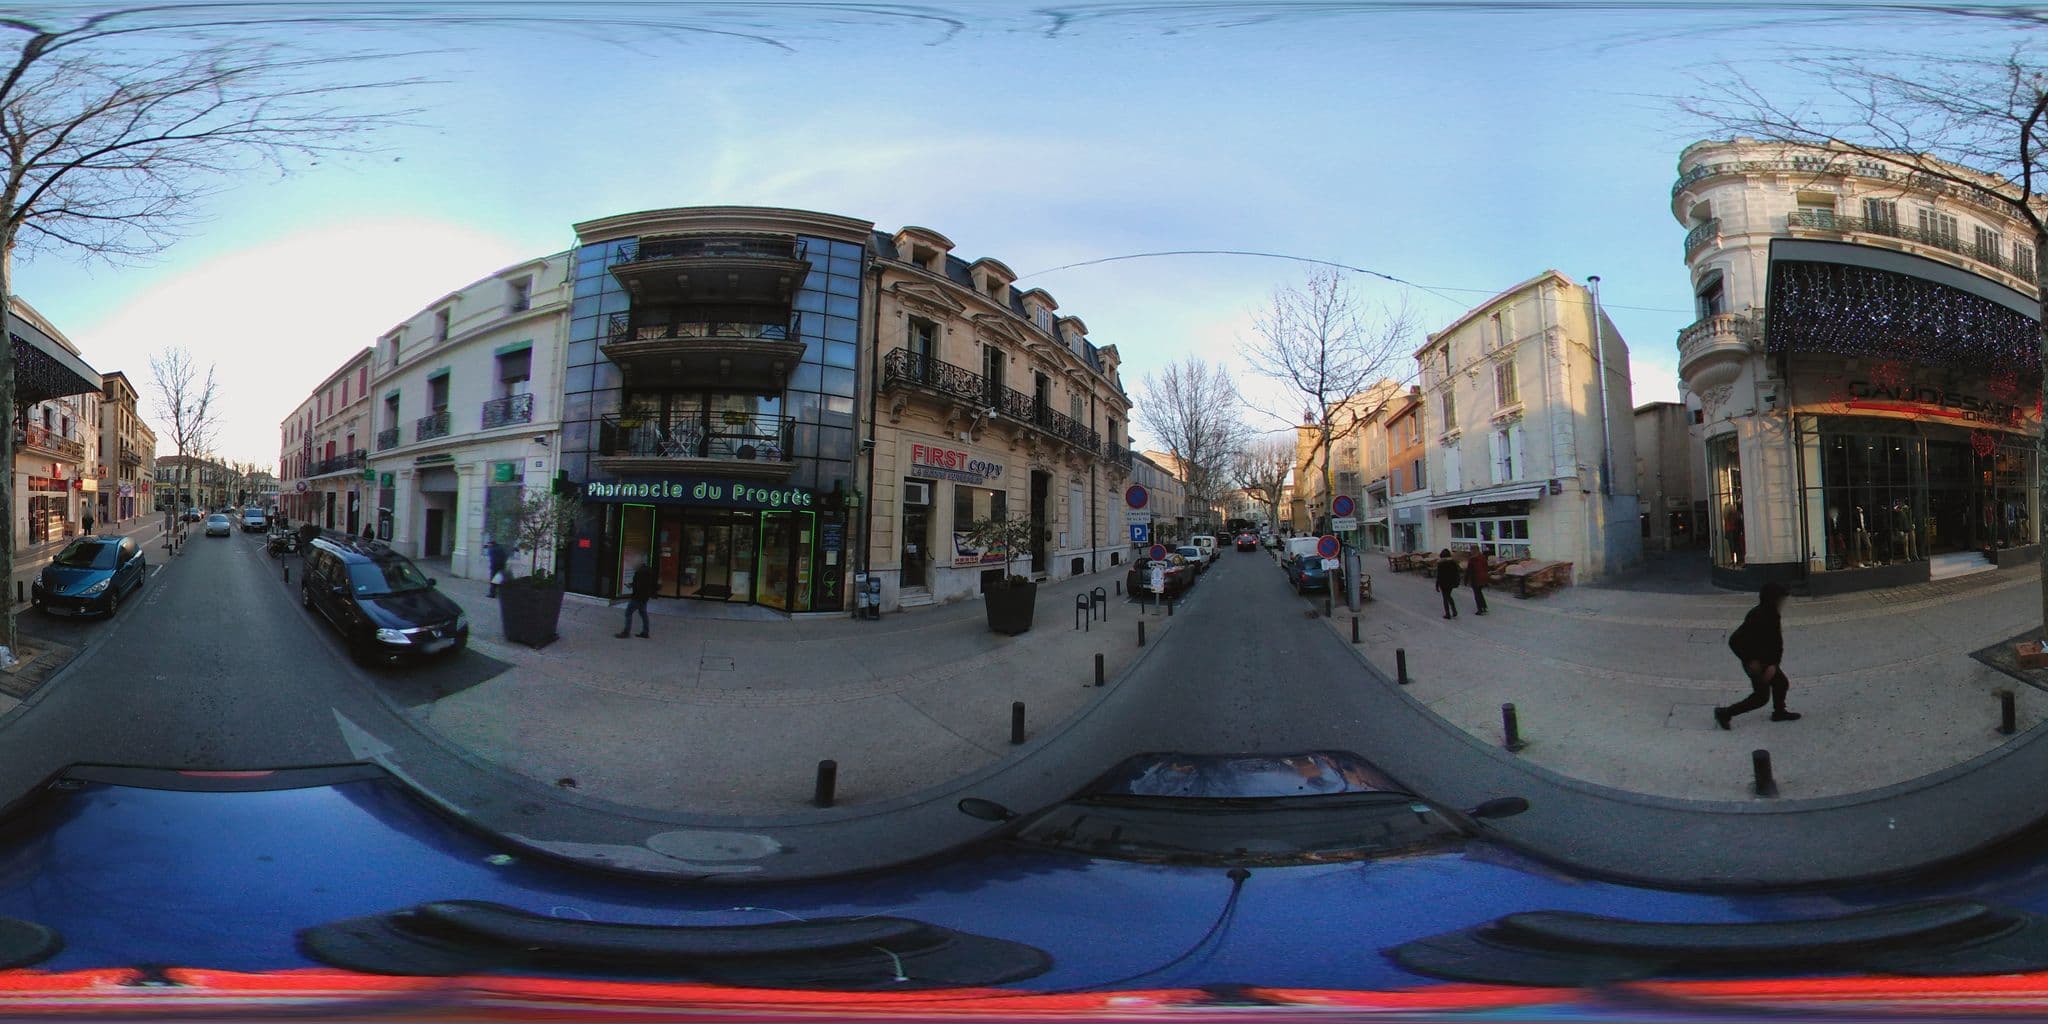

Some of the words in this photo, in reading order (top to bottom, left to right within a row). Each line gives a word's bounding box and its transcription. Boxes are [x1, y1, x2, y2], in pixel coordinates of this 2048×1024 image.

[912, 443, 968, 470] FIRST
[969, 459, 1003, 477] copy
[588, 480, 683, 498] Pharmacie
[693, 482, 722, 500] du
[733, 484, 812, 507] Progrès
[1134, 527, 1143, 539] P
